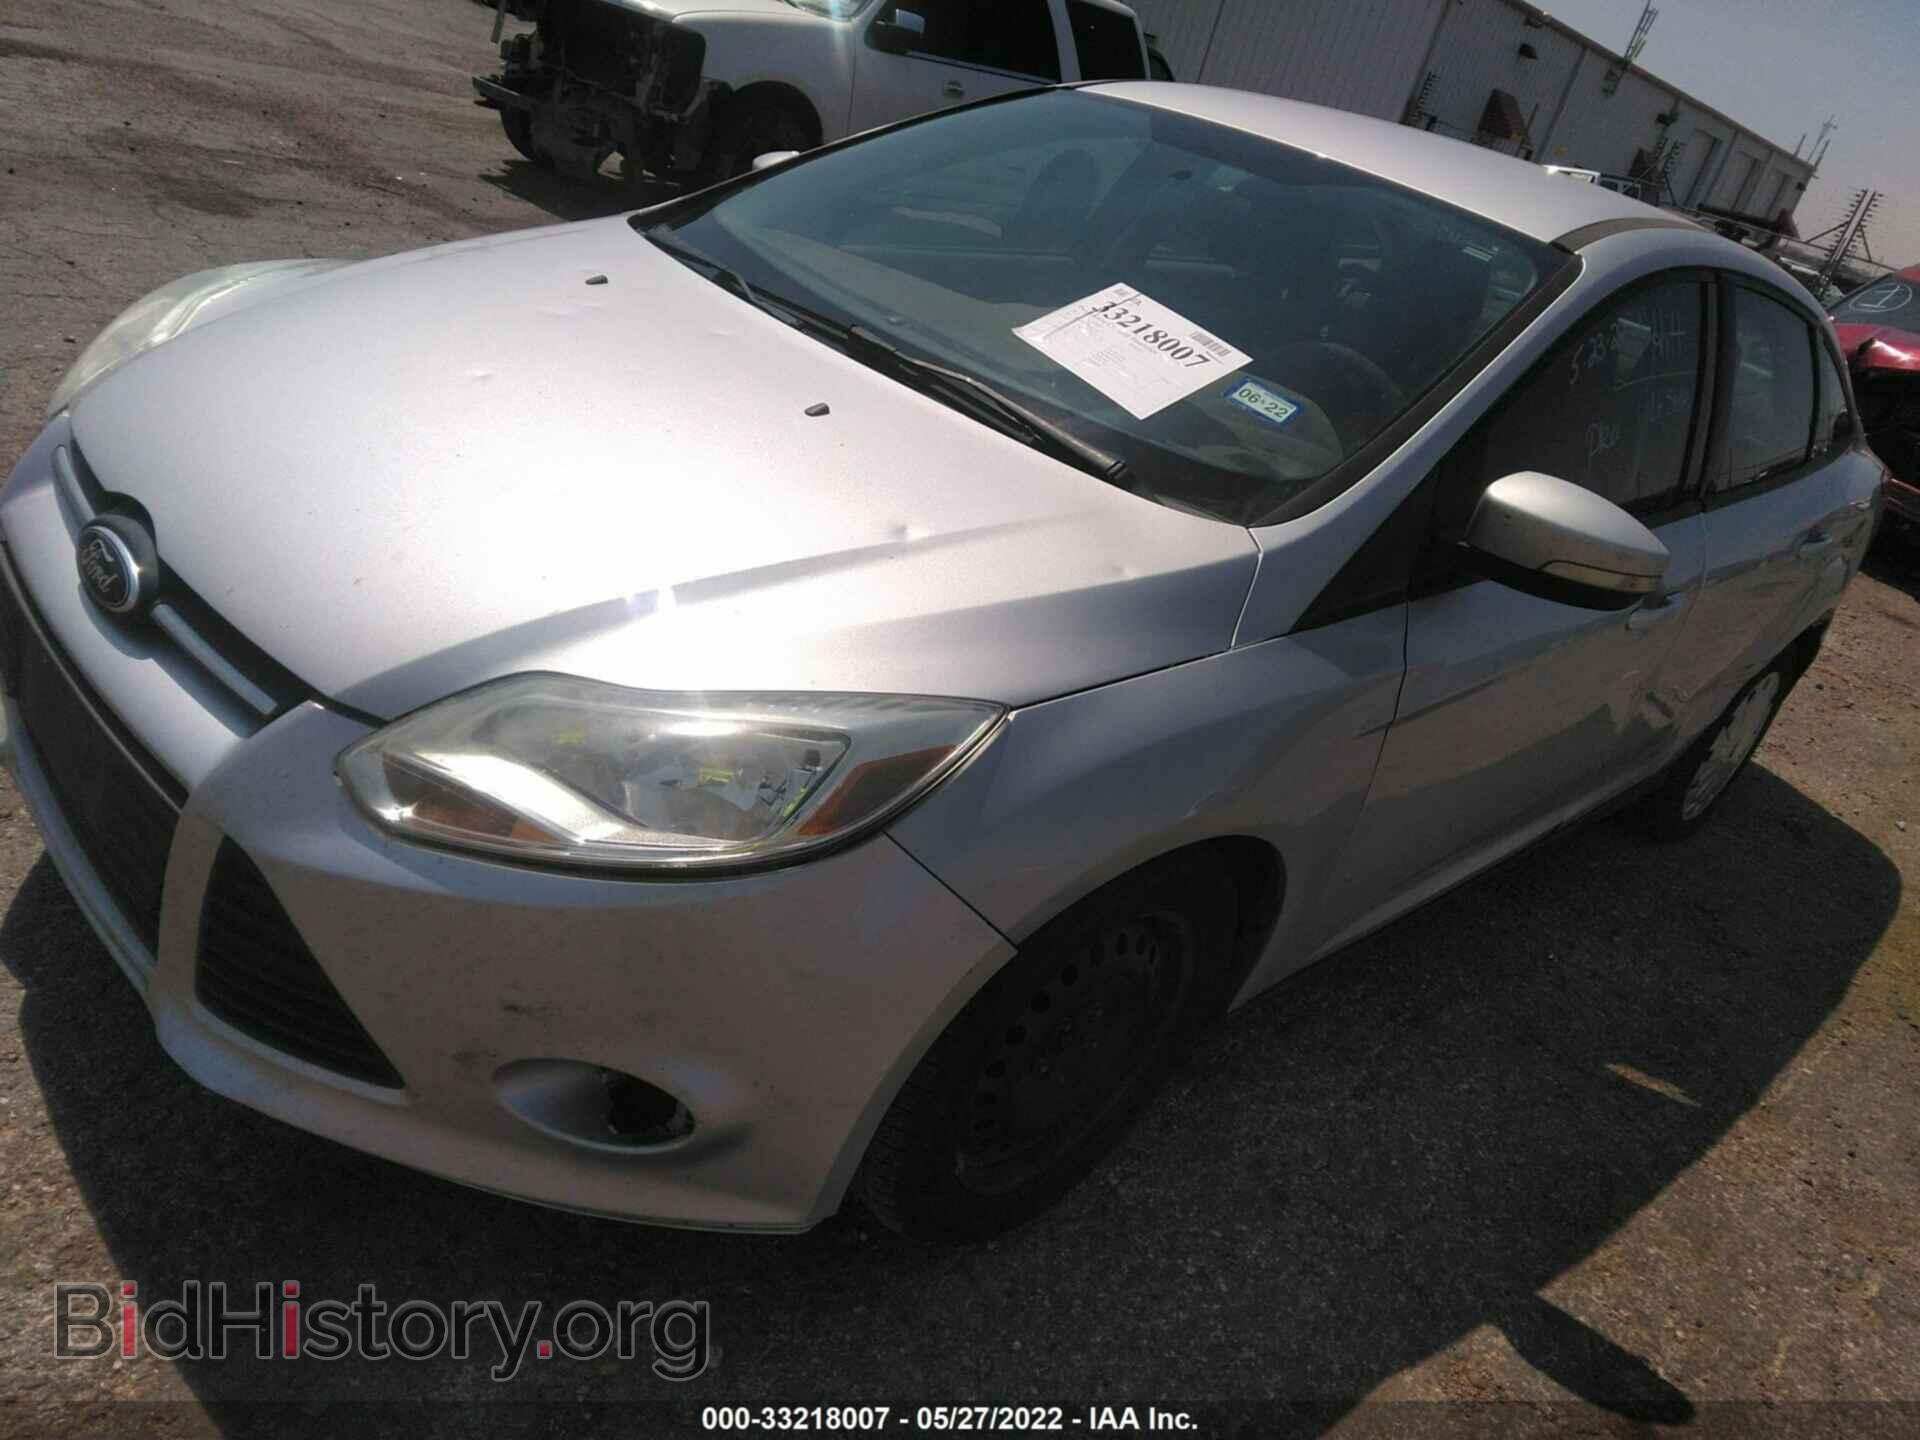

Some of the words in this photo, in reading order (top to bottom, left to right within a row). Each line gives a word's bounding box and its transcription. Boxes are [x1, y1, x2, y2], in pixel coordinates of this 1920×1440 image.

[1092, 301, 1210, 368] 33218007
[1238, 387, 1260, 404] 06
[1266, 401, 1290, 419] 22
[80, 539, 119, 593] Ford
